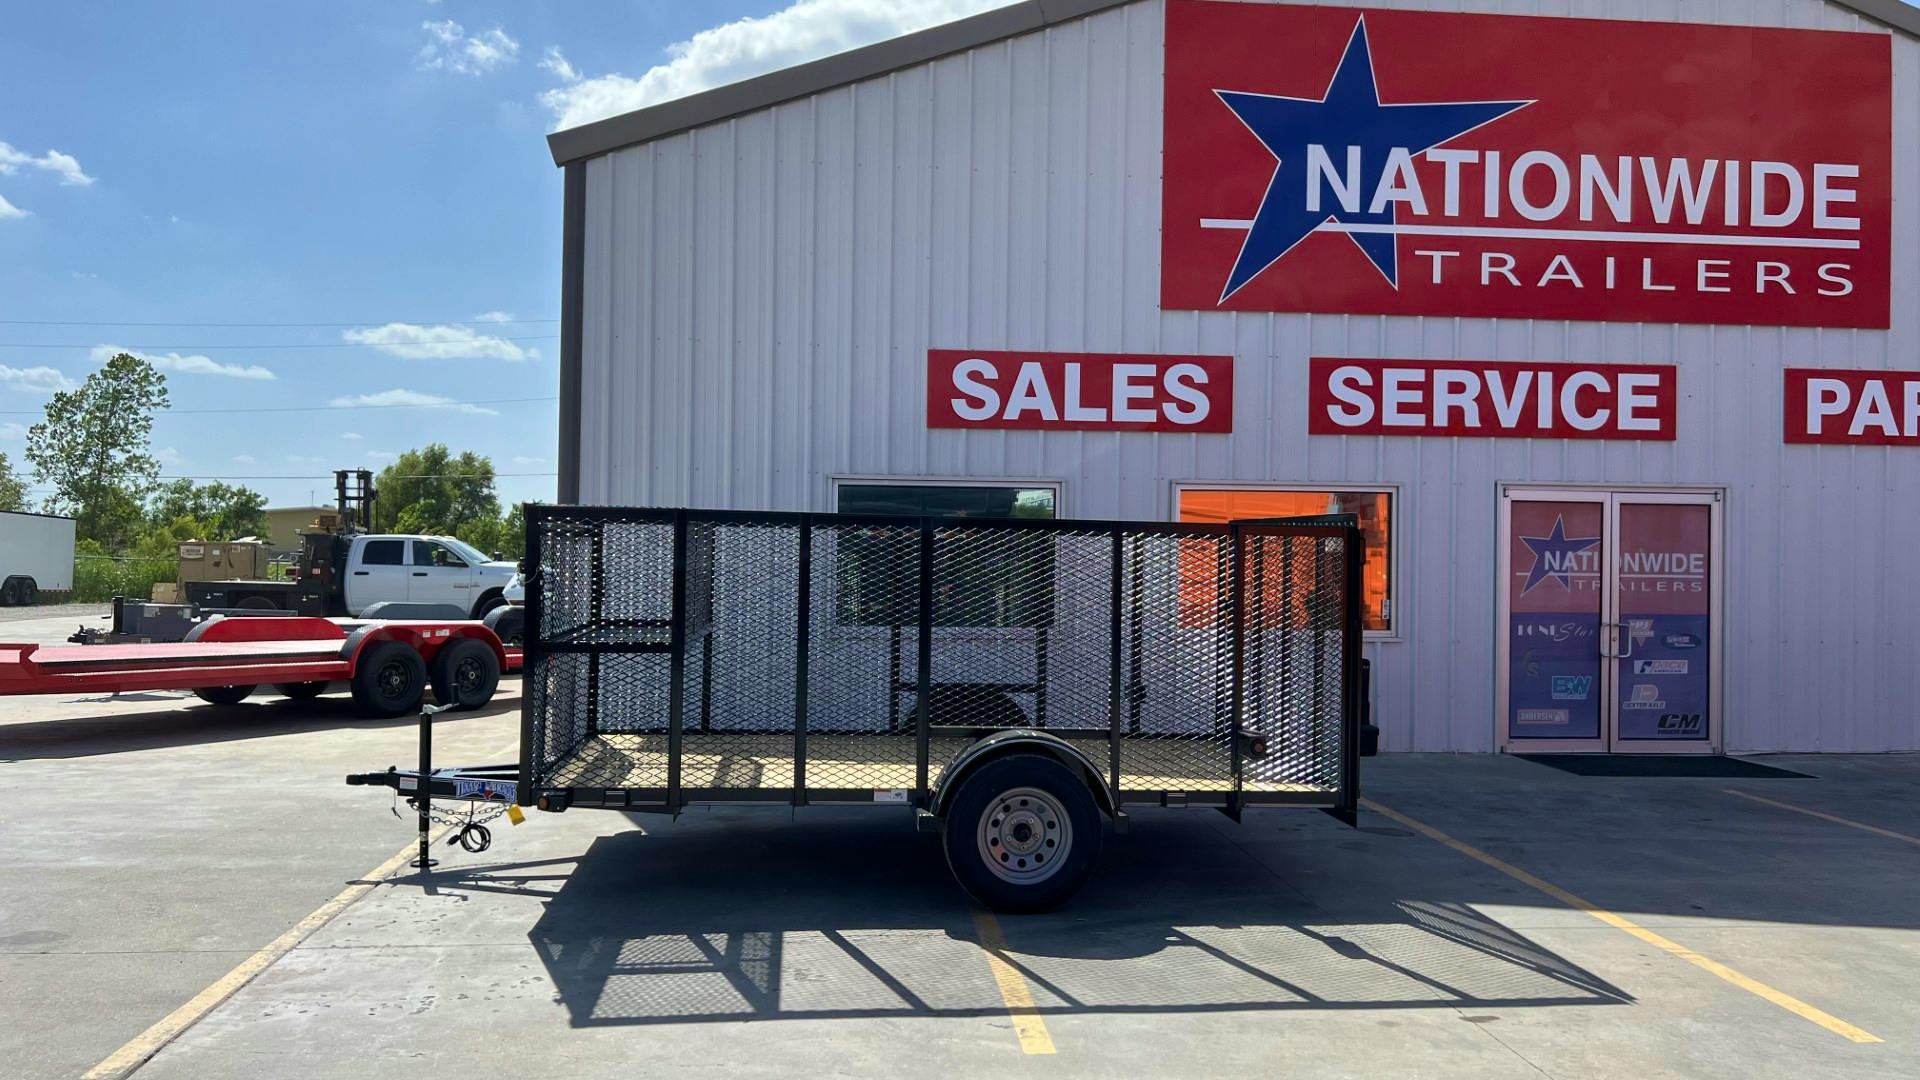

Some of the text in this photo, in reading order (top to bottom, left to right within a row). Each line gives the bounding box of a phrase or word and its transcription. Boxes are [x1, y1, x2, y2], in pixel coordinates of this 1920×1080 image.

[1306, 144, 1860, 230] NATIONWIDE
[1414, 250, 1854, 296] TRAILERS
[951, 358, 1210, 425] SALES
[1326, 365, 1661, 431] SERVICE
[1544, 550, 1704, 573] NATINWIDE
